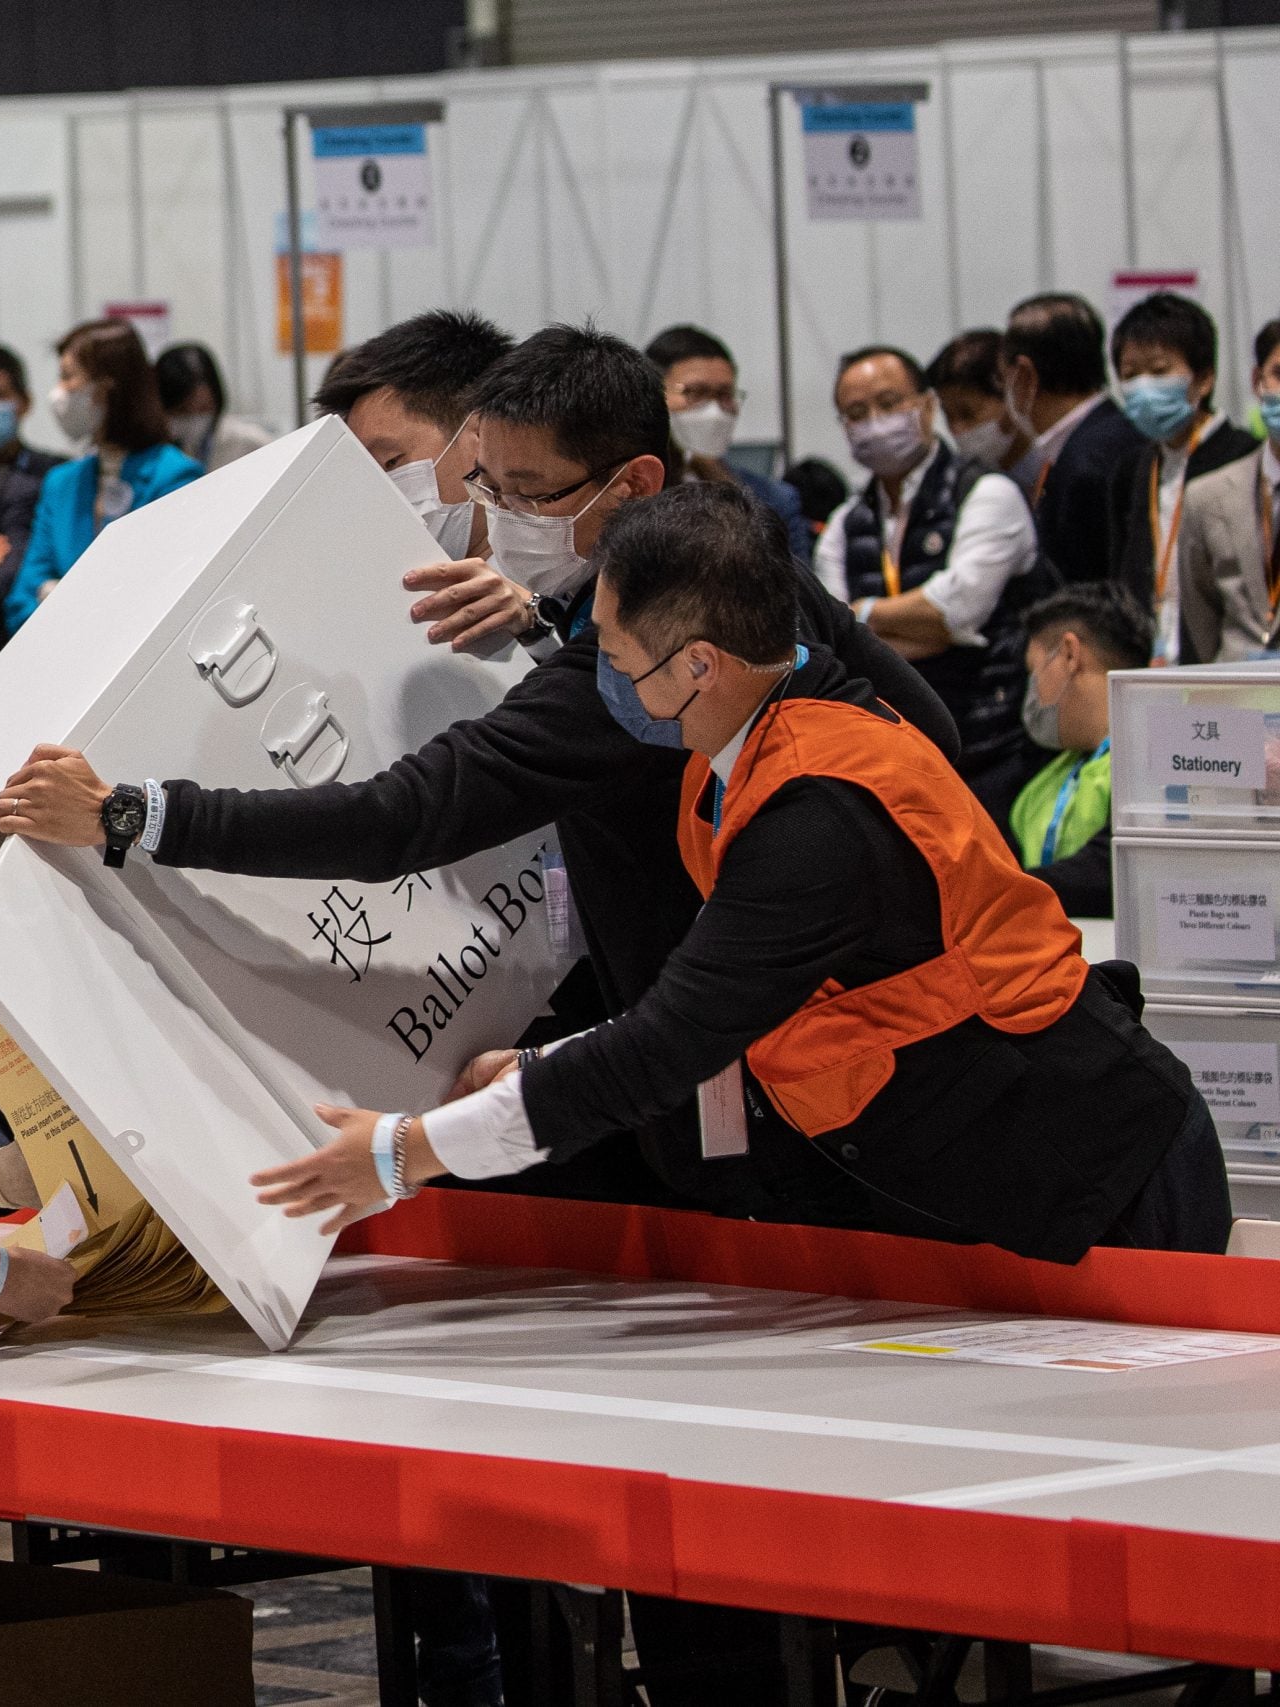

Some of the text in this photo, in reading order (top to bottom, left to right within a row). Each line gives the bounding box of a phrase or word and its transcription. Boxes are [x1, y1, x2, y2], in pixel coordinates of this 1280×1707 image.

[1192, 721, 1220, 741] 文具
[1172, 755, 1241, 777] Stationery
[385, 923, 501, 1065] Ballot
[21, 1125, 39, 1139] Please
[38, 1115, 53, 1129] insert
[50, 1126, 61, 1137] this
